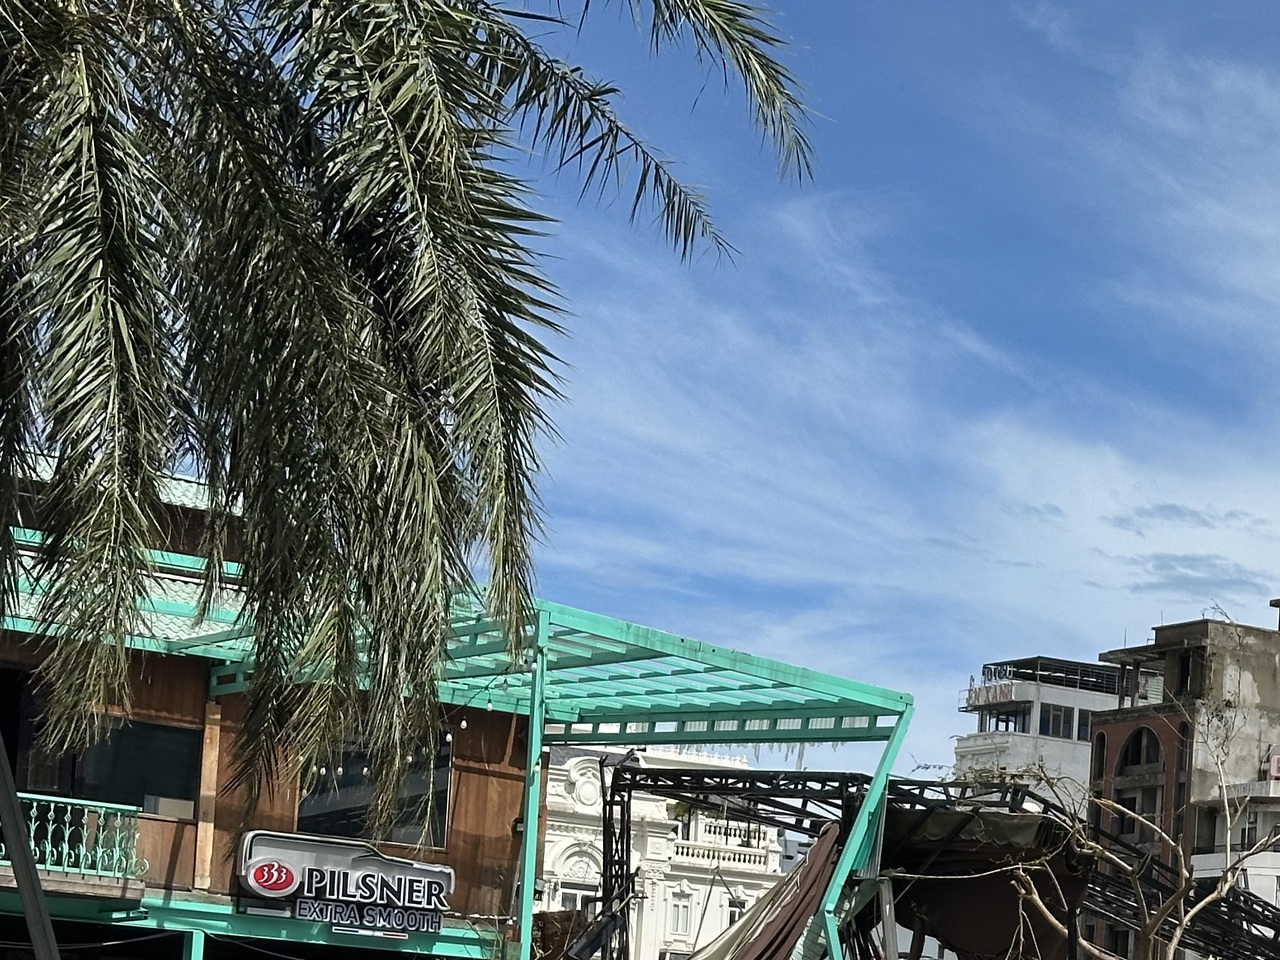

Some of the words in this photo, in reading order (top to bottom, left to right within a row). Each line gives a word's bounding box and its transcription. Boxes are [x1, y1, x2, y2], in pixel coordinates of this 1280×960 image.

[257, 861, 288, 886] 333
[304, 866, 450, 910] PILSNER
[296, 898, 361, 925] EXTRA
[363, 905, 444, 933] SMOOTH
